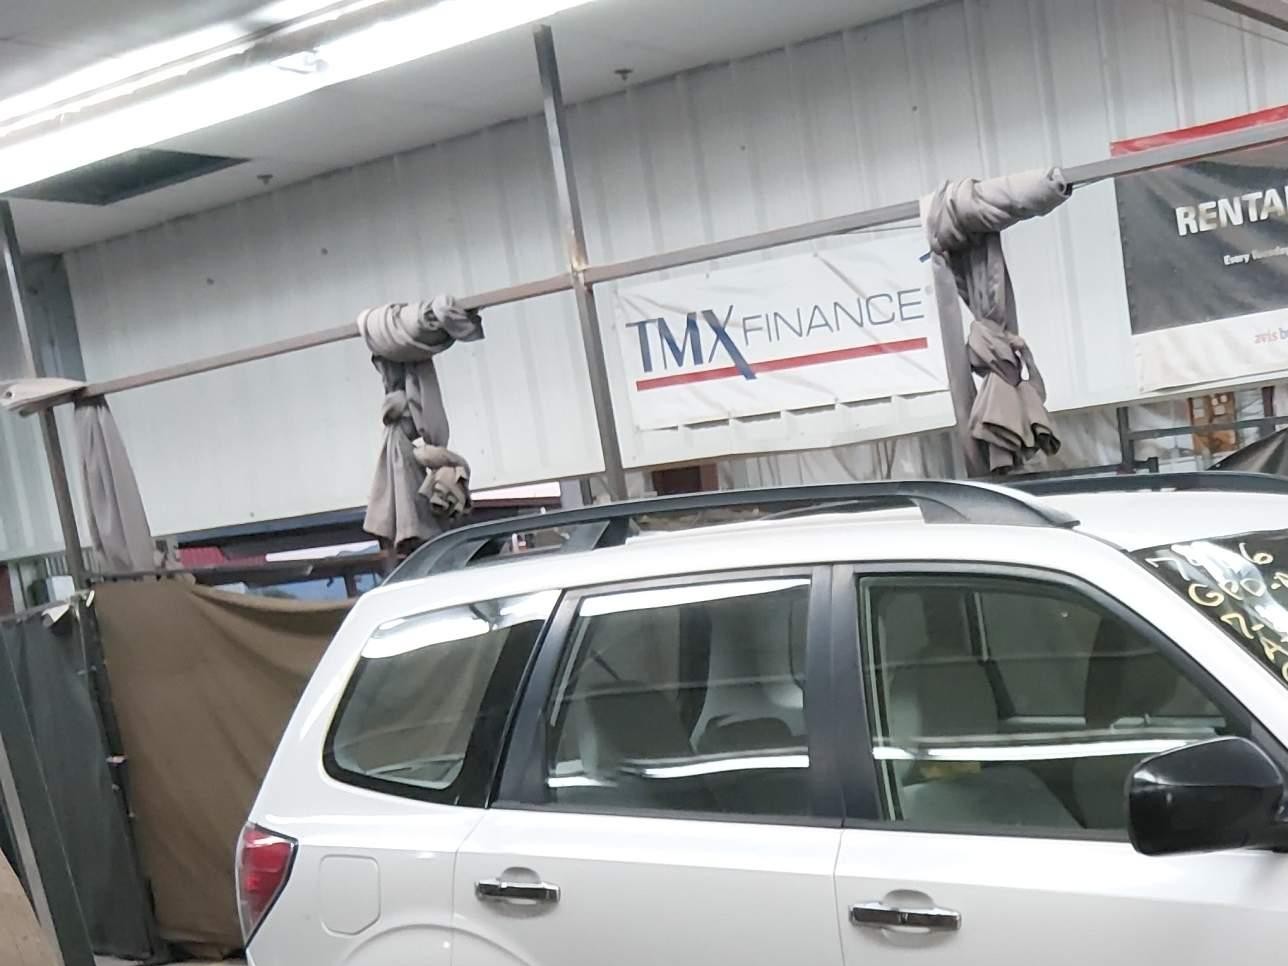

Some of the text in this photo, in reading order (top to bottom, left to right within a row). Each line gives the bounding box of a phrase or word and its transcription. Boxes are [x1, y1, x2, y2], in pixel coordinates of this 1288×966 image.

[1223, 253, 1250, 266] Every
[625, 288, 926, 380] TMX FINANCE
[1254, 329, 1279, 345] avis
